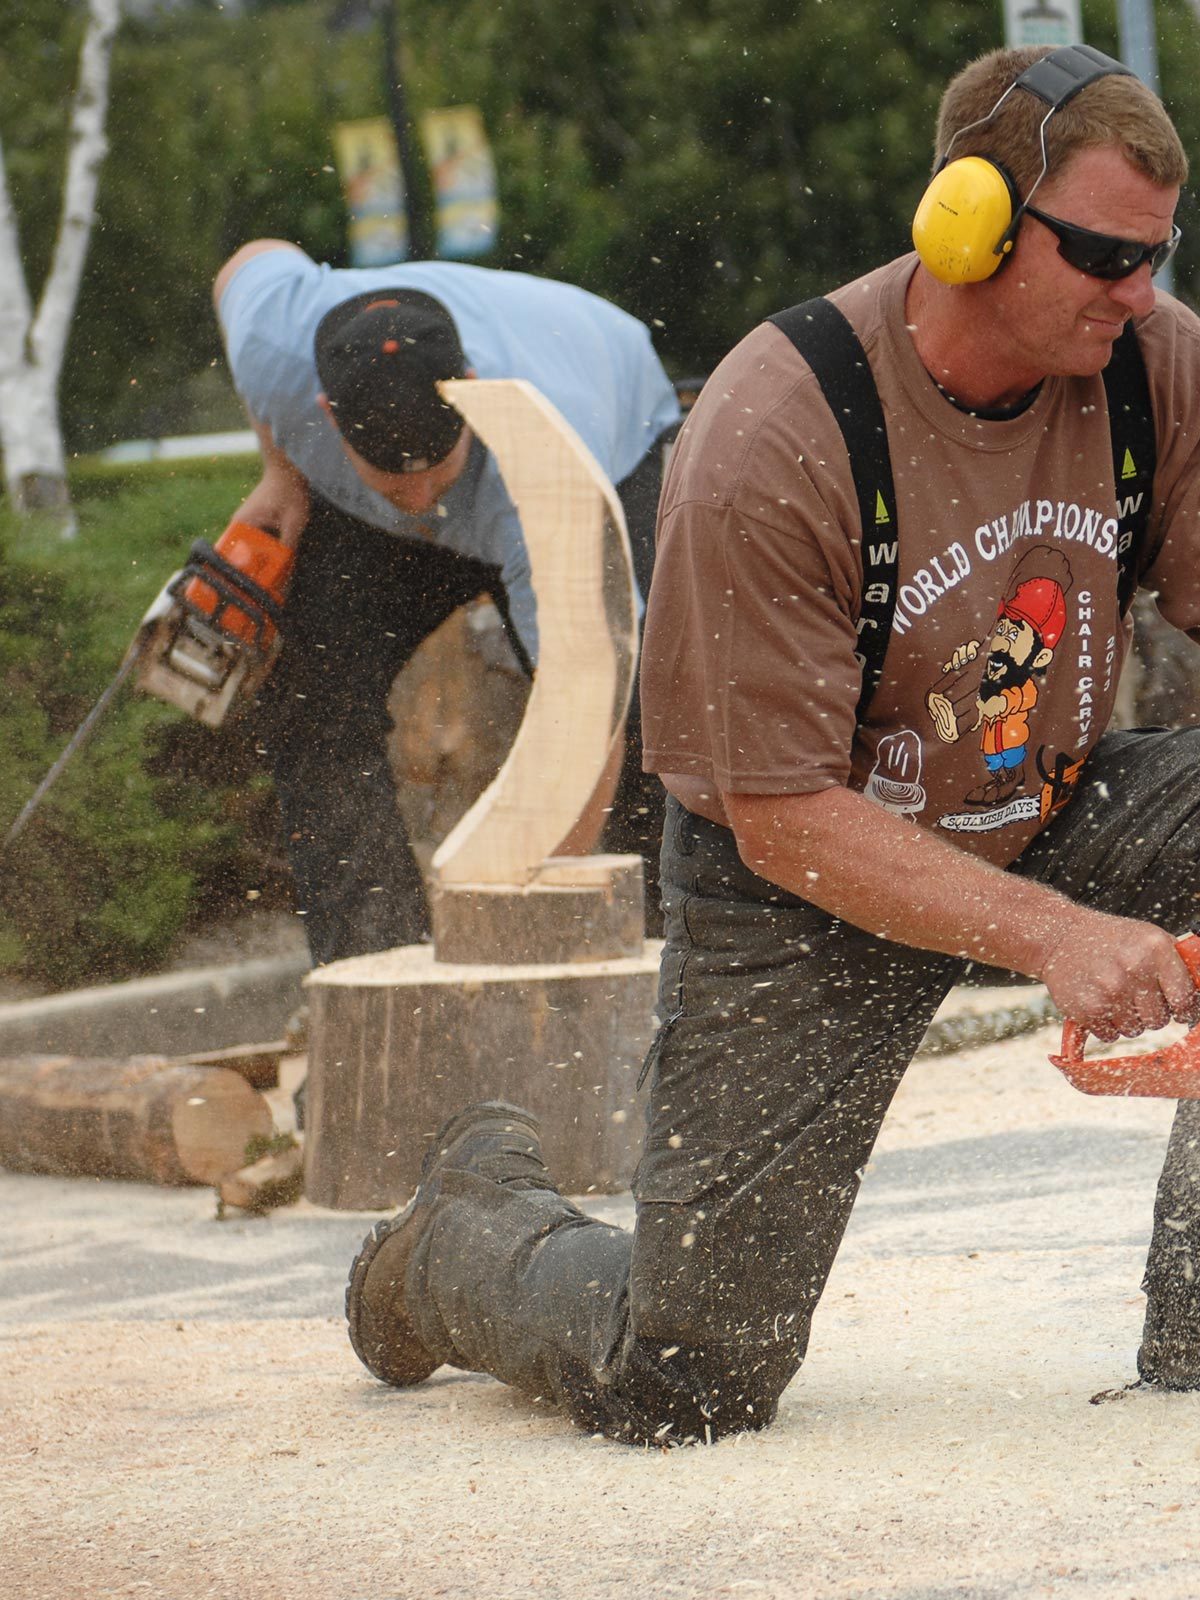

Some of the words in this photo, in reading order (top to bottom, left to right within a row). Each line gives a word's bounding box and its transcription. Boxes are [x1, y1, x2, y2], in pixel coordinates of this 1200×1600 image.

[892, 541, 972, 635] WORLD
[1078, 590, 1093, 668] CHAIR
[1076, 676, 1093, 749] CARVE
[1005, 802, 1034, 818] DAYS
